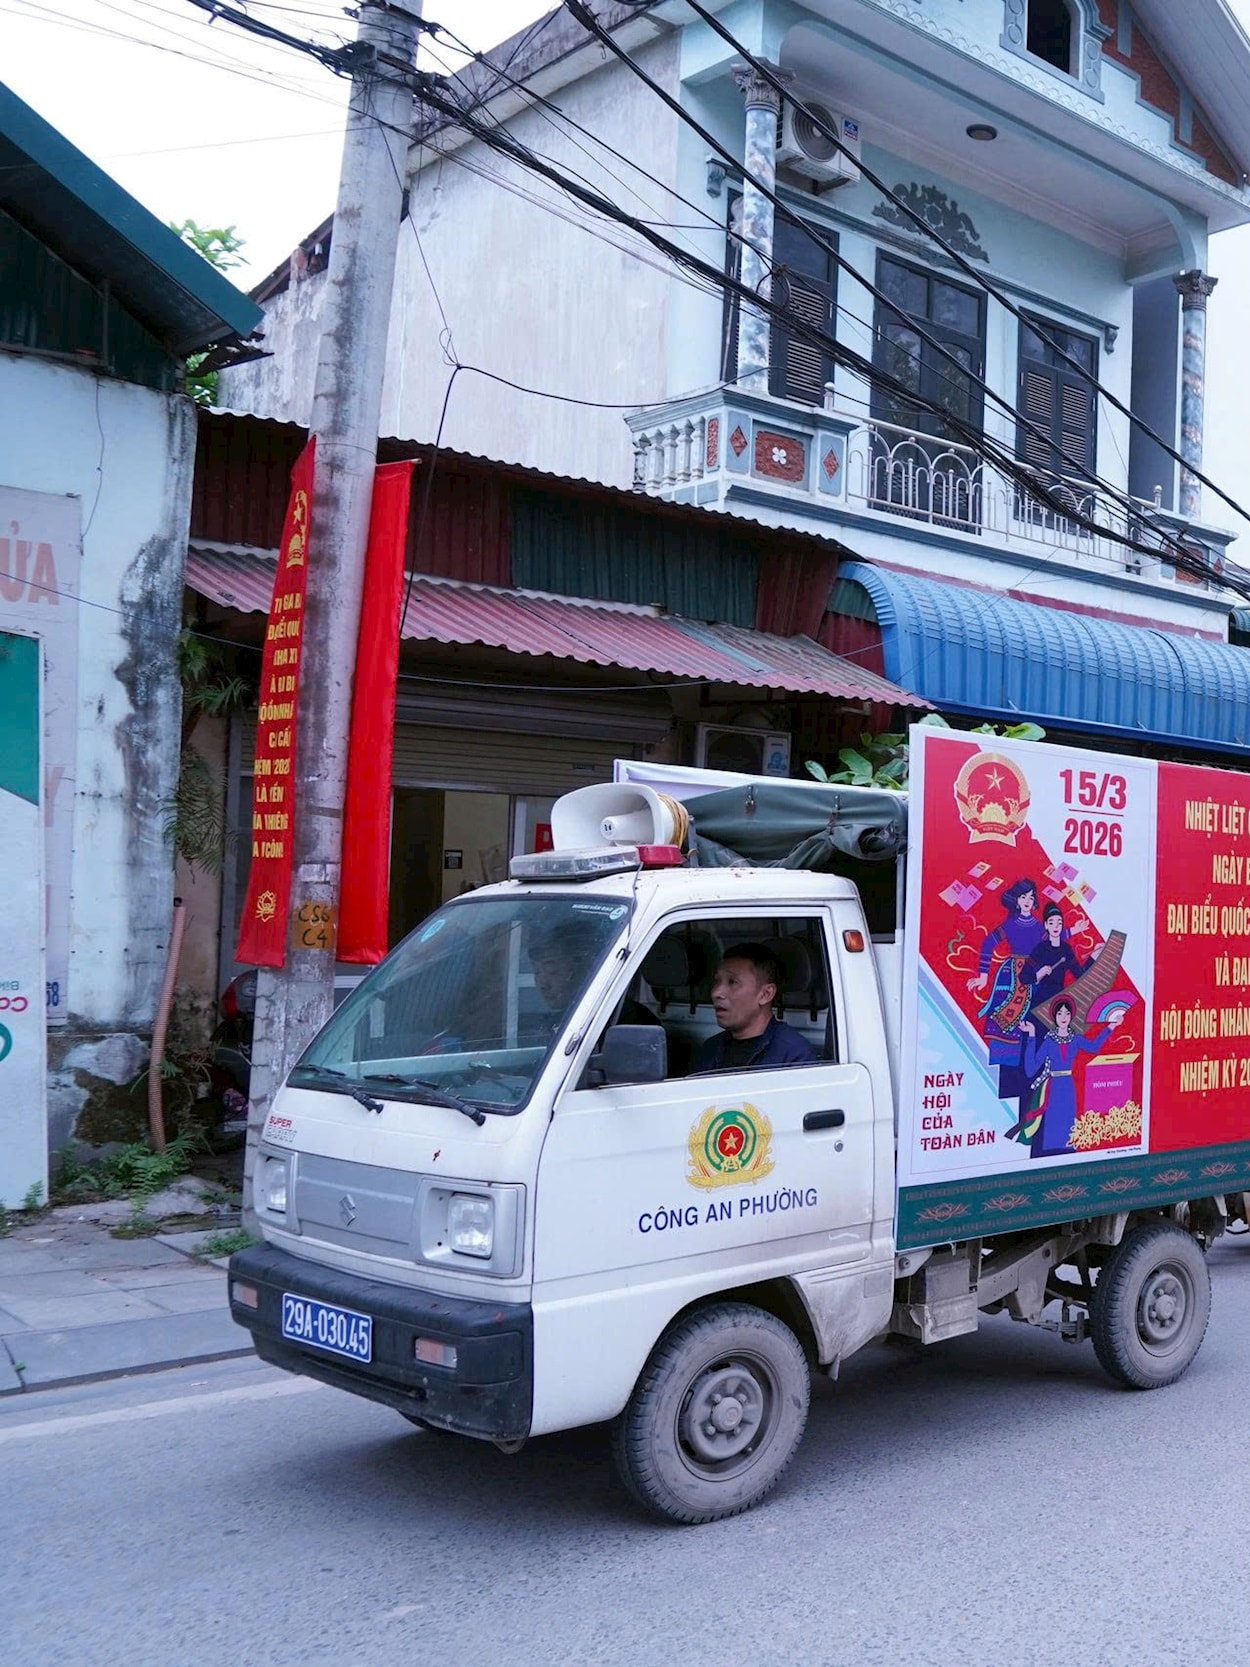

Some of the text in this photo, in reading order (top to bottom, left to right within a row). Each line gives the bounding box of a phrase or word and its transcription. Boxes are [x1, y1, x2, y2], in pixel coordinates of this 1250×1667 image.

[1059, 769, 1127, 810] 15/3
[1063, 818, 1123, 858] 2026
[1185, 796, 1219, 839] NHIỆT
[1222, 799, 1246, 841] LIỆT
[1212, 850, 1244, 885] NGÀY
[1167, 904, 1188, 941] ĐẠI
[1191, 893, 1218, 935] BIỂU
[1221, 897, 1250, 938] QUỐC
[1215, 950, 1230, 986] VÀ
[1160, 1004, 1181, 1047] HỘI
[1184, 999, 1217, 1040] ĐỒNG
[924, 1070, 965, 1088] NGÀY
[1180, 1054, 1219, 1097] NHIỆM
[1222, 1052, 1237, 1089] KỲ
[922, 1092, 951, 1111] HỘI
[922, 1112, 953, 1130] CỦA
[920, 1128, 996, 1152] TOÀN DÂN
[638, 1187, 818, 1234] CÔNG AN PHƯỜNG
[285, 1300, 369, 1355] 29A-030.45
